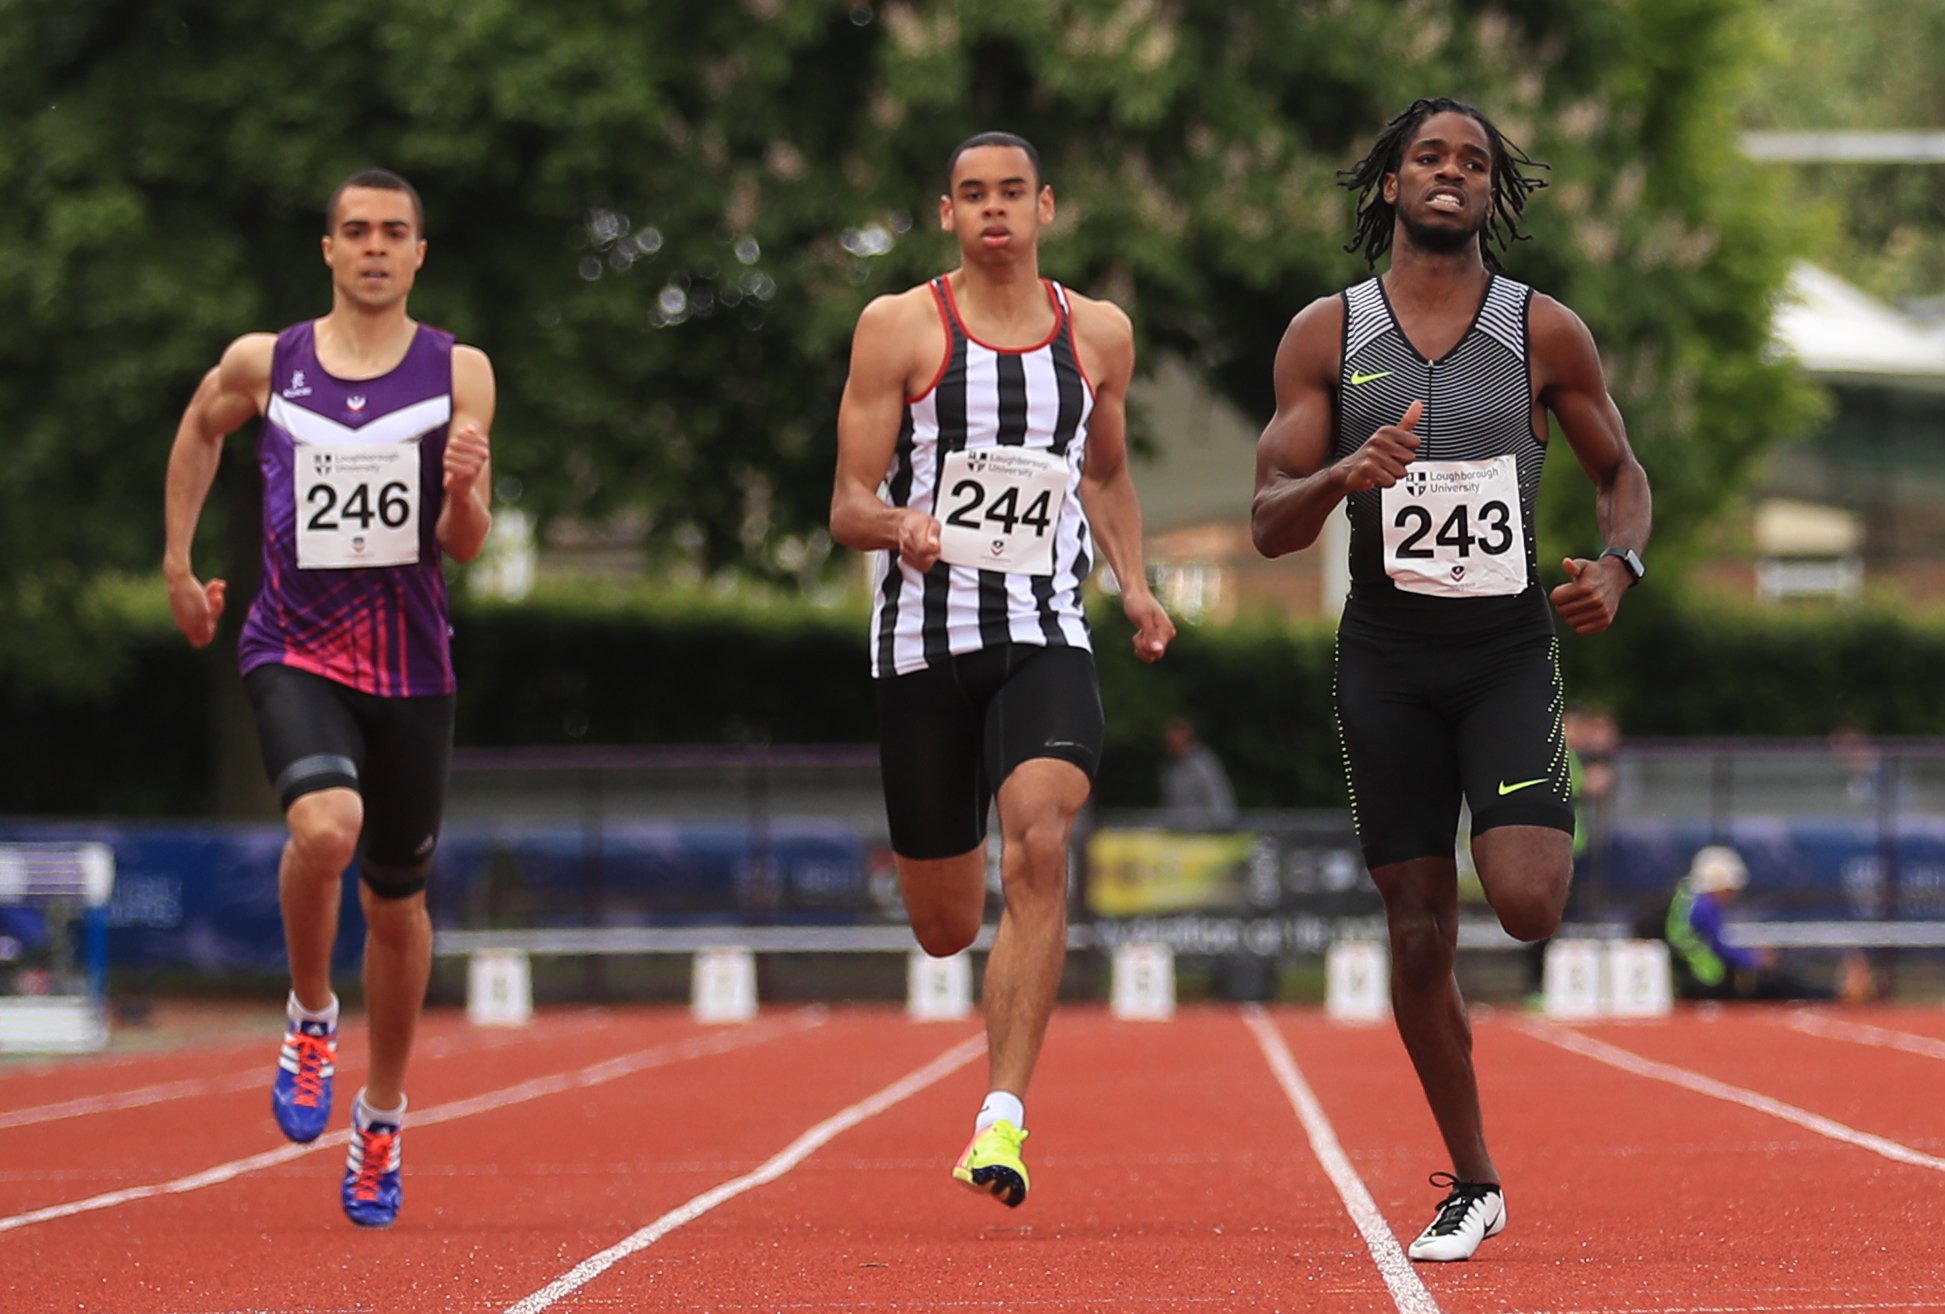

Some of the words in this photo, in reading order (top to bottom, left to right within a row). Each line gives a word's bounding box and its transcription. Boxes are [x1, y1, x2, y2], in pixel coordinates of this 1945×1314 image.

[1430, 467, 1499, 482] Loughborough
[1430, 482, 1480, 494] University
[307, 482, 410, 531] 246
[946, 479, 1052, 537] 244
[1394, 500, 1513, 559] 243
